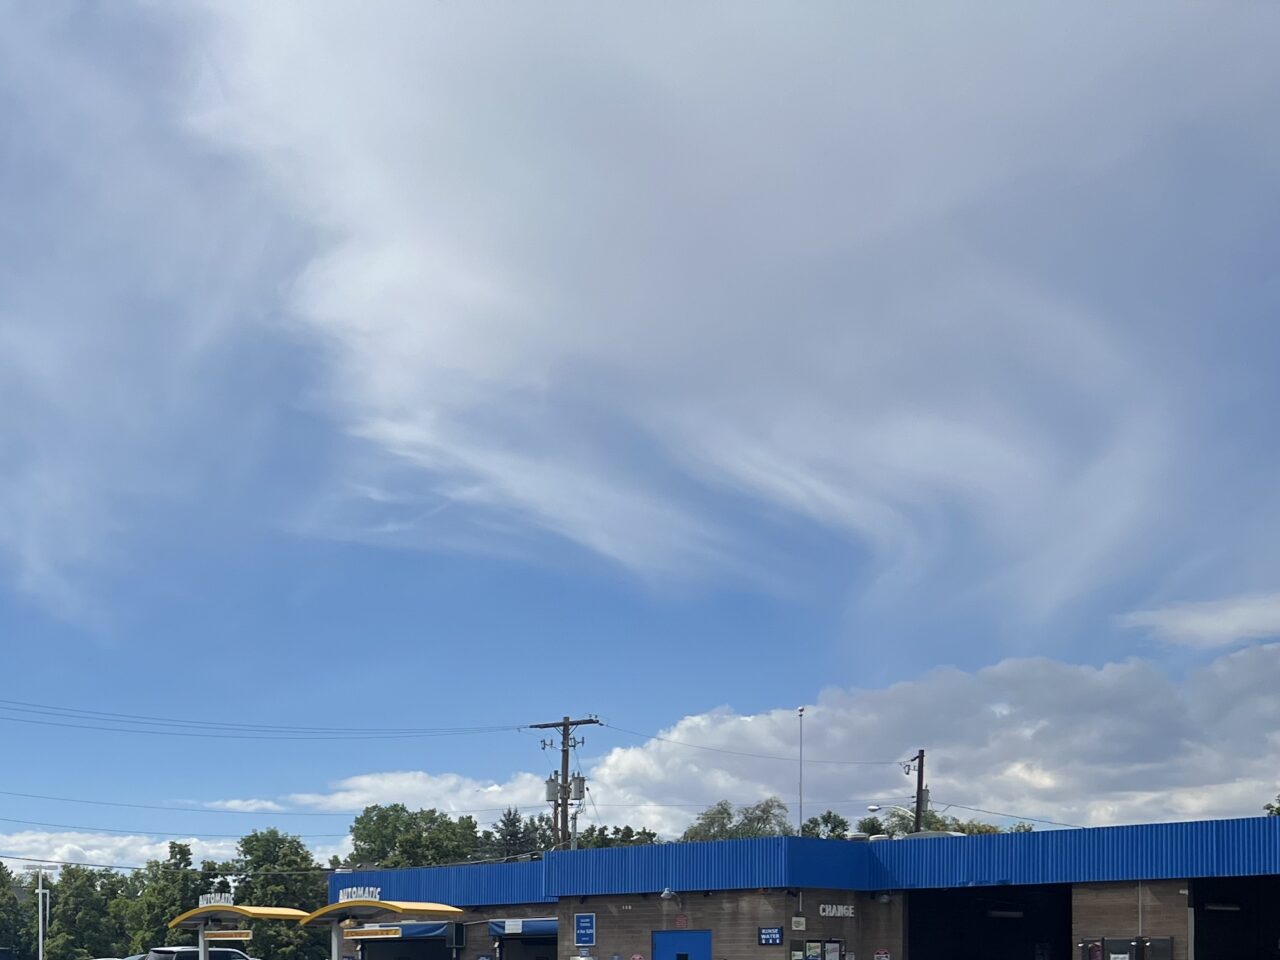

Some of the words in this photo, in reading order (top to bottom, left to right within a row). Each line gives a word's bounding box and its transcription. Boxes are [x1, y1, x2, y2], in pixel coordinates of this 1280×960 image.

[199, 893, 235, 906] AUTOMATIC
[339, 886, 381, 902] AUTOMATIC
[819, 904, 855, 917] CHANGE
